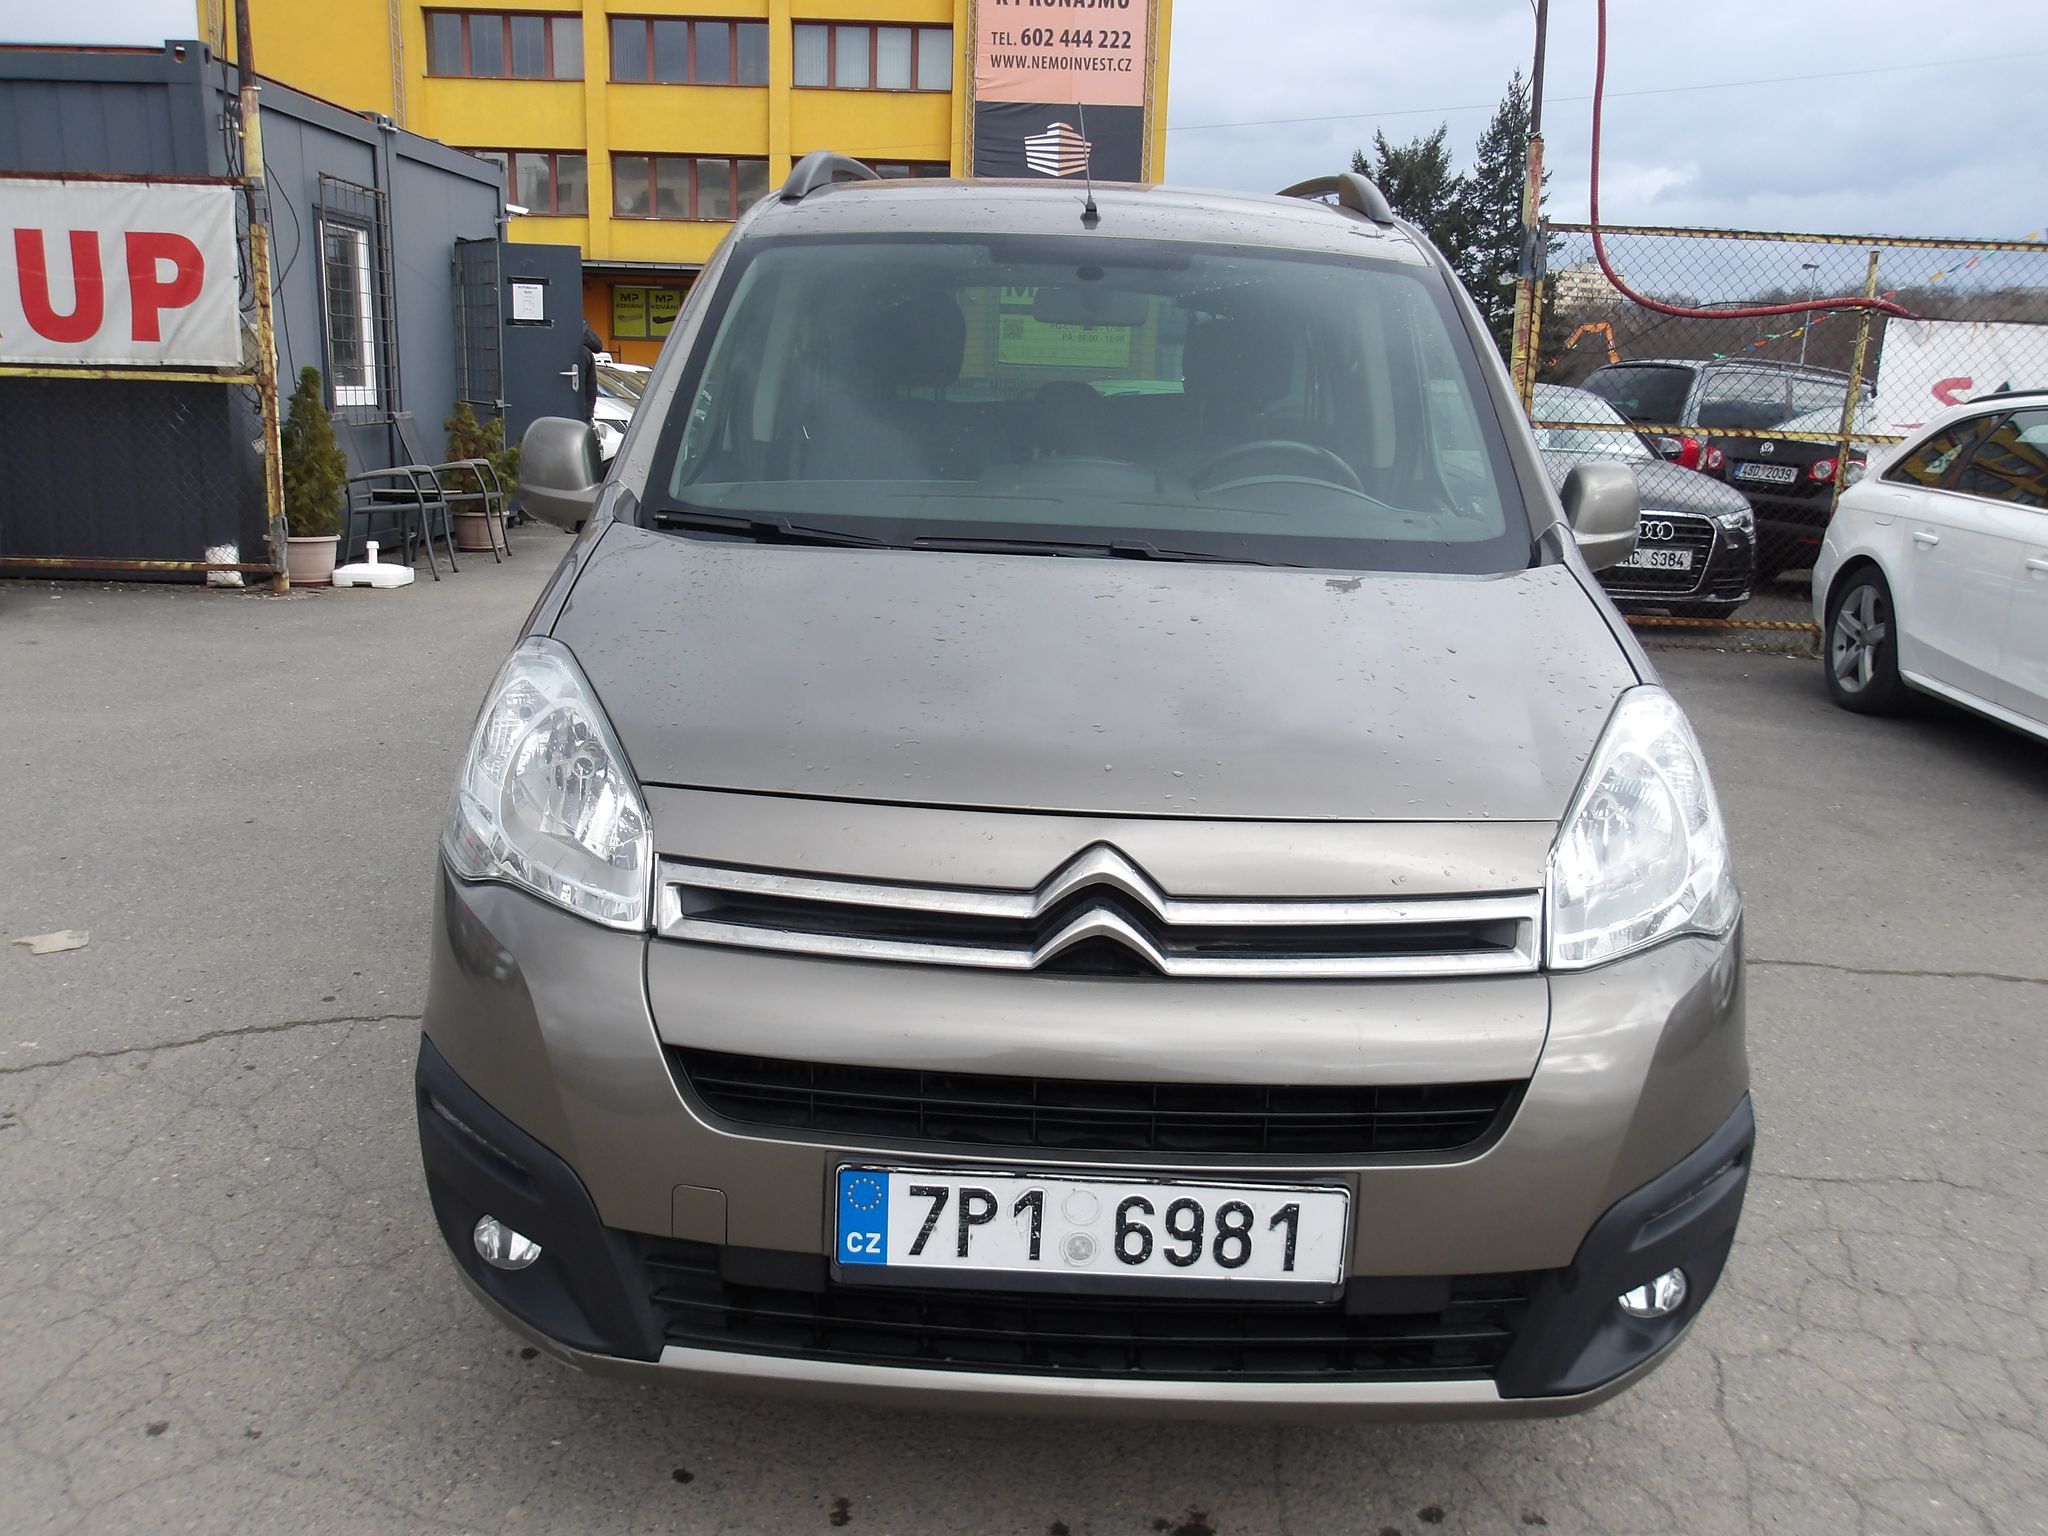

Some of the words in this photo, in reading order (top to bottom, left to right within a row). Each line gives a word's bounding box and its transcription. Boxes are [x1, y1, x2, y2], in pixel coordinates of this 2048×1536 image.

[991, 31, 1017, 46] TEL.
[1020, 28, 1054, 47] 602
[1059, 29, 1093, 48] 444
[1098, 30, 1132, 49] 222
[990, 54, 1132, 71] WWW.NEMOINVEST.CZ
[0, 228, 205, 343] UP
[1765, 467, 1792, 481] 2039
[1651, 552, 1684, 567] S384
[907, 1184, 1047, 1261] 7P1
[1113, 1194, 1301, 1273] 6981
[846, 1231, 881, 1254] CZ
